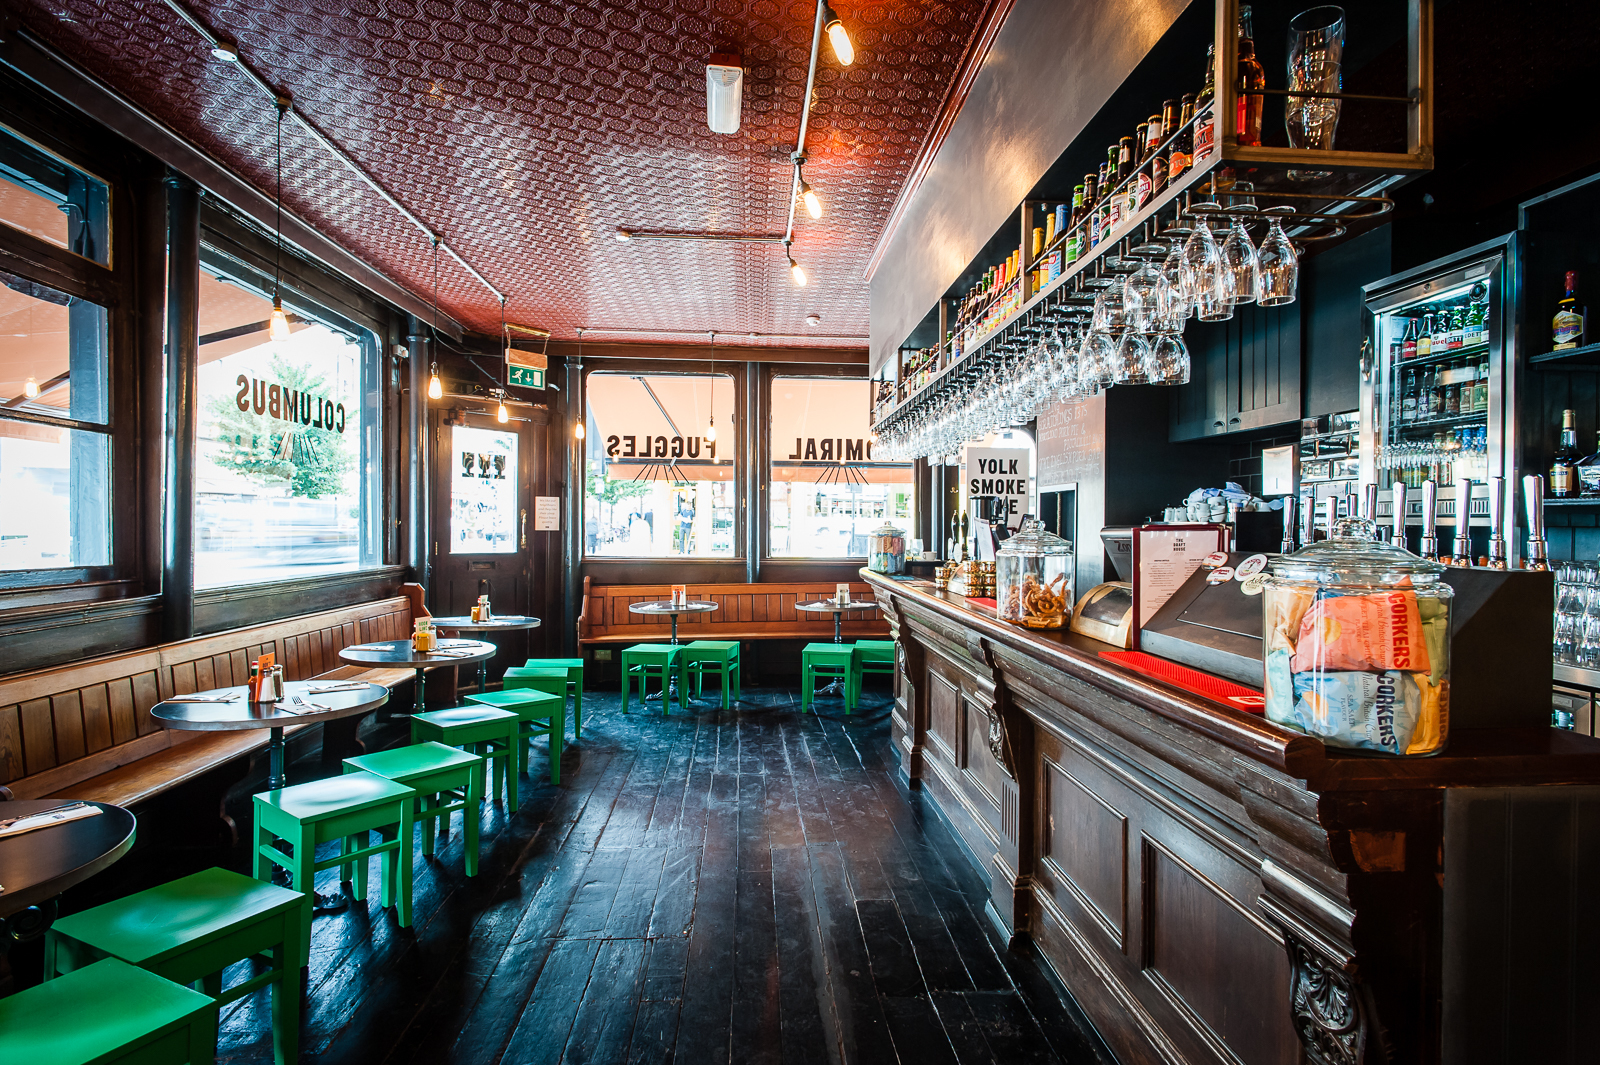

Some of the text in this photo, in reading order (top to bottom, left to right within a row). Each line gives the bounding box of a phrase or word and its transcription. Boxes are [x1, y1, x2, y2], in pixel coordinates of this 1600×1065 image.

[1431, 337, 1447, 346] uvel
[978, 458, 1018, 475] YOLK
[970, 478, 1026, 495] SMOKE
[1388, 593, 1411, 668] CORKERS
[1348, 709, 1356, 728] SALT
[1364, 700, 1376, 722] British
[1376, 674, 1396, 747] CORKERS
